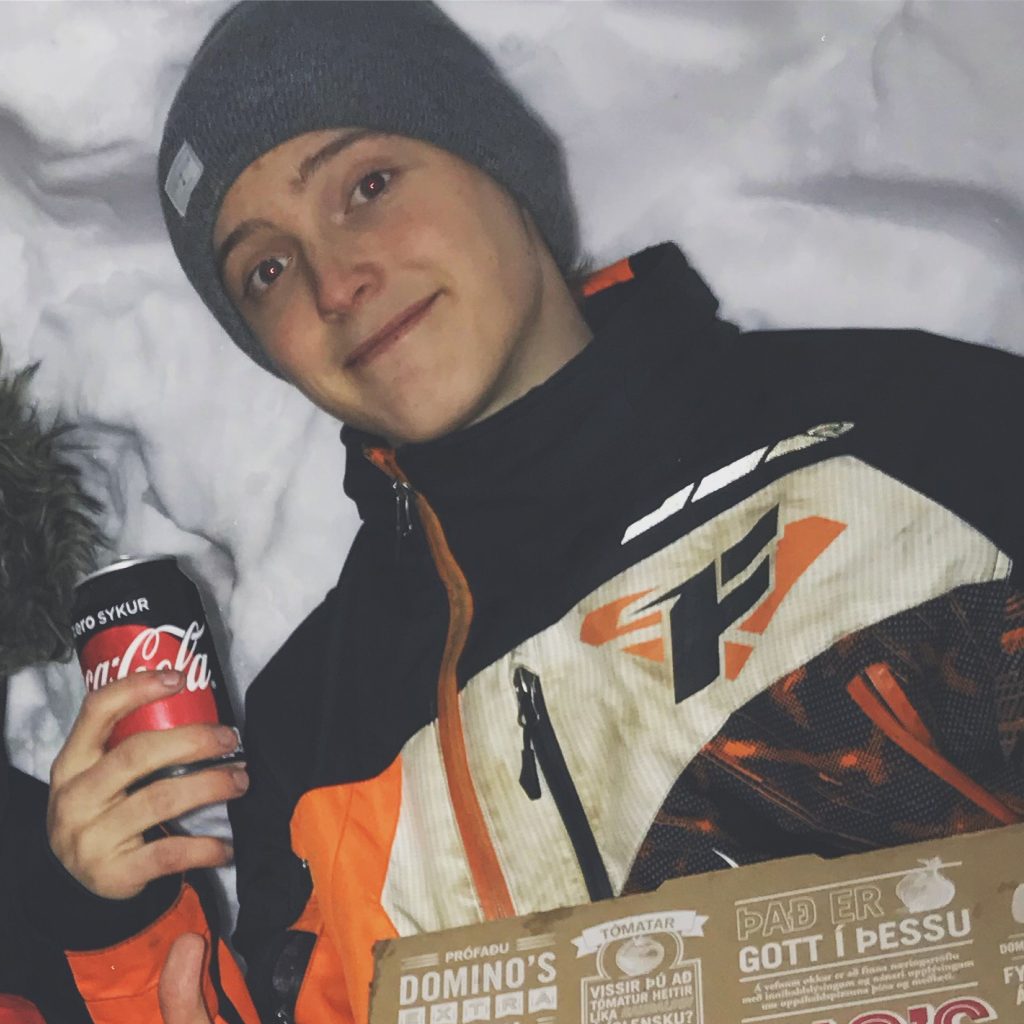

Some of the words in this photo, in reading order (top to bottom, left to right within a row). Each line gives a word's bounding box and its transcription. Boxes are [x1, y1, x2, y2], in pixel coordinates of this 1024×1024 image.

[96, 596, 150, 626] SYKUR
[735, 896, 817, 940] ÞAÐ
[828, 884, 884, 924] ER
[602, 917, 674, 939] TÓMATAR
[738, 934, 822, 972] GOTT
[834, 923, 844, 957] Í
[855, 909, 970, 952] ÞESSU
[445, 942, 509, 962] PRÓFAÐU
[399, 952, 555, 1004] DOMINO'S
[590, 979, 640, 999] VISSIR
[645, 971, 666, 990] ÞÚ
[671, 970, 692, 985] AÐ
[591, 991, 647, 1010] TÓMATUR
[652, 984, 692, 1000] HEITIR
[590, 1008, 617, 1023] LÍKA
